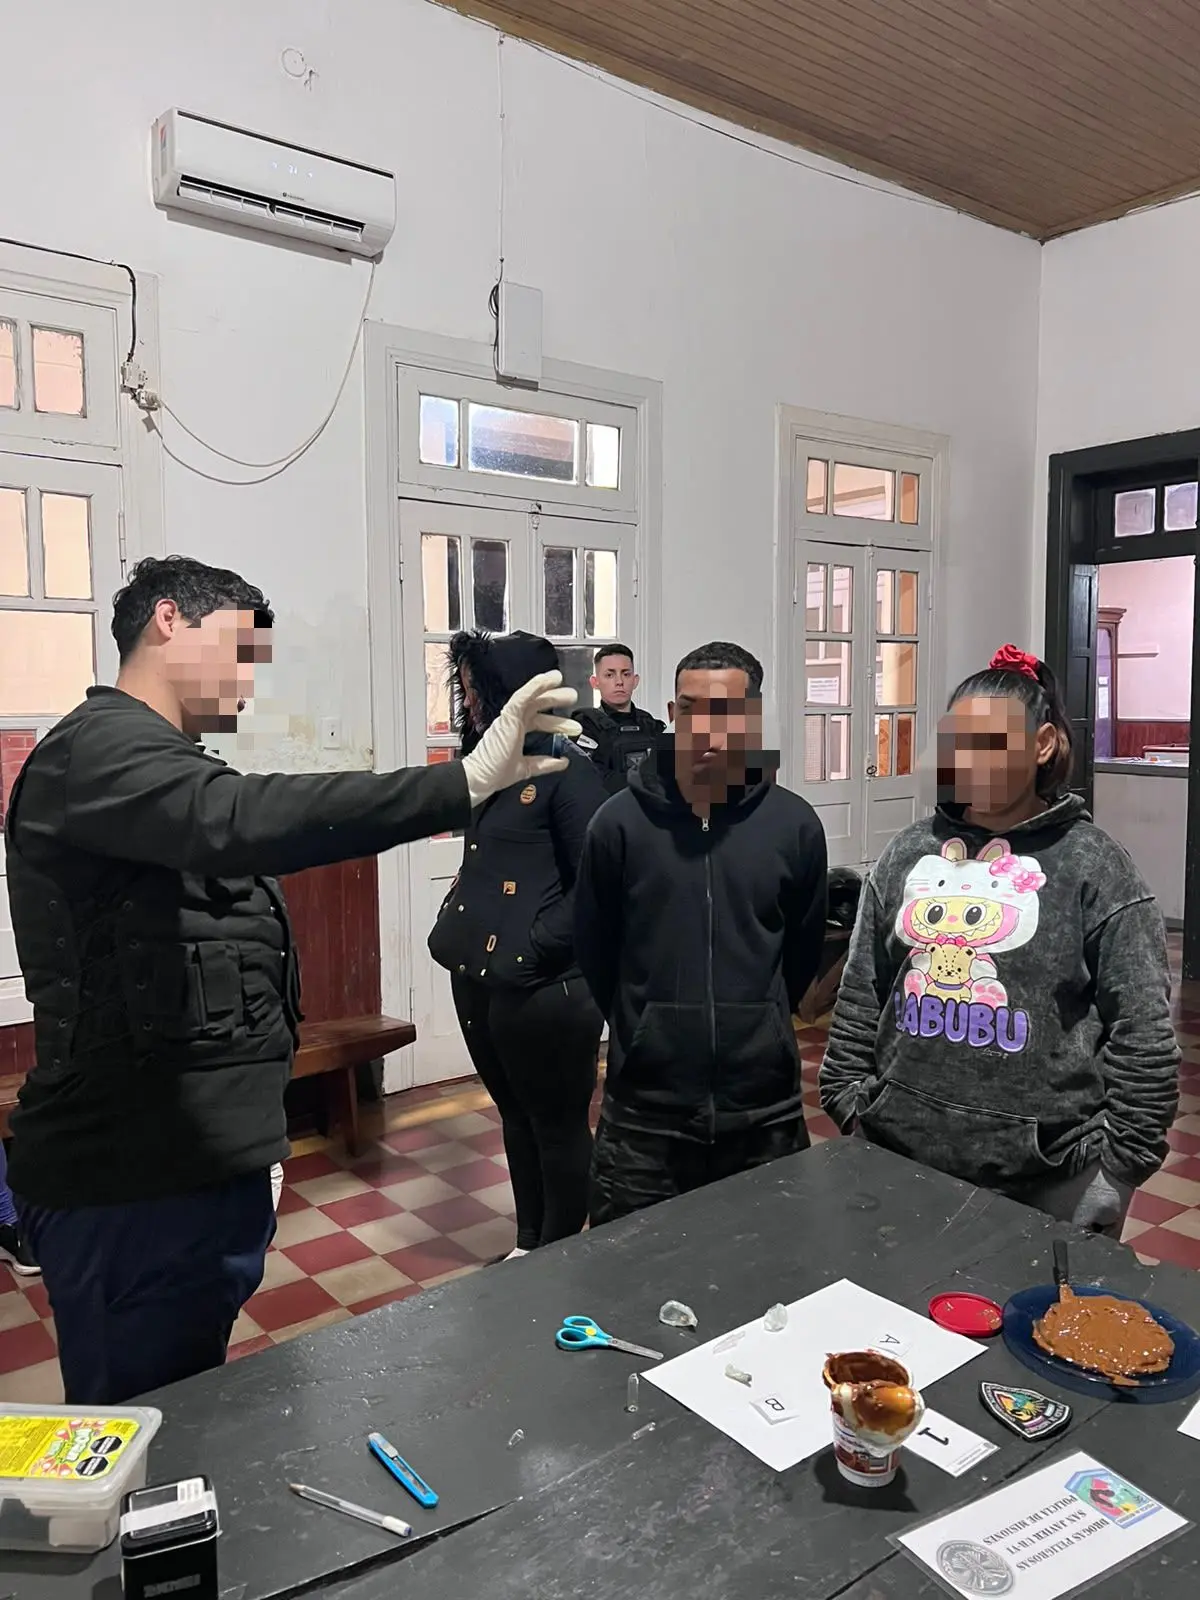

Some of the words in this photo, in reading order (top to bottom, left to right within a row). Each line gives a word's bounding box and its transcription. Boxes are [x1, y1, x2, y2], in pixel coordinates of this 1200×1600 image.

[880, 1334, 901, 1345] A
[765, 1398, 784, 1412] B
[918, 1427, 949, 1446] 1
[1040, 1494, 1078, 1517] POLICIA
[1026, 1514, 1044, 1524] DE
[1065, 1509, 1087, 1525] SAN
[983, 1519, 1030, 1546] MISIONES
[1033, 1520, 1068, 1541] JAVIER
[1071, 1518, 1110, 1541] DROGAS
[1016, 1537, 1075, 1571] PELIGROSAS
